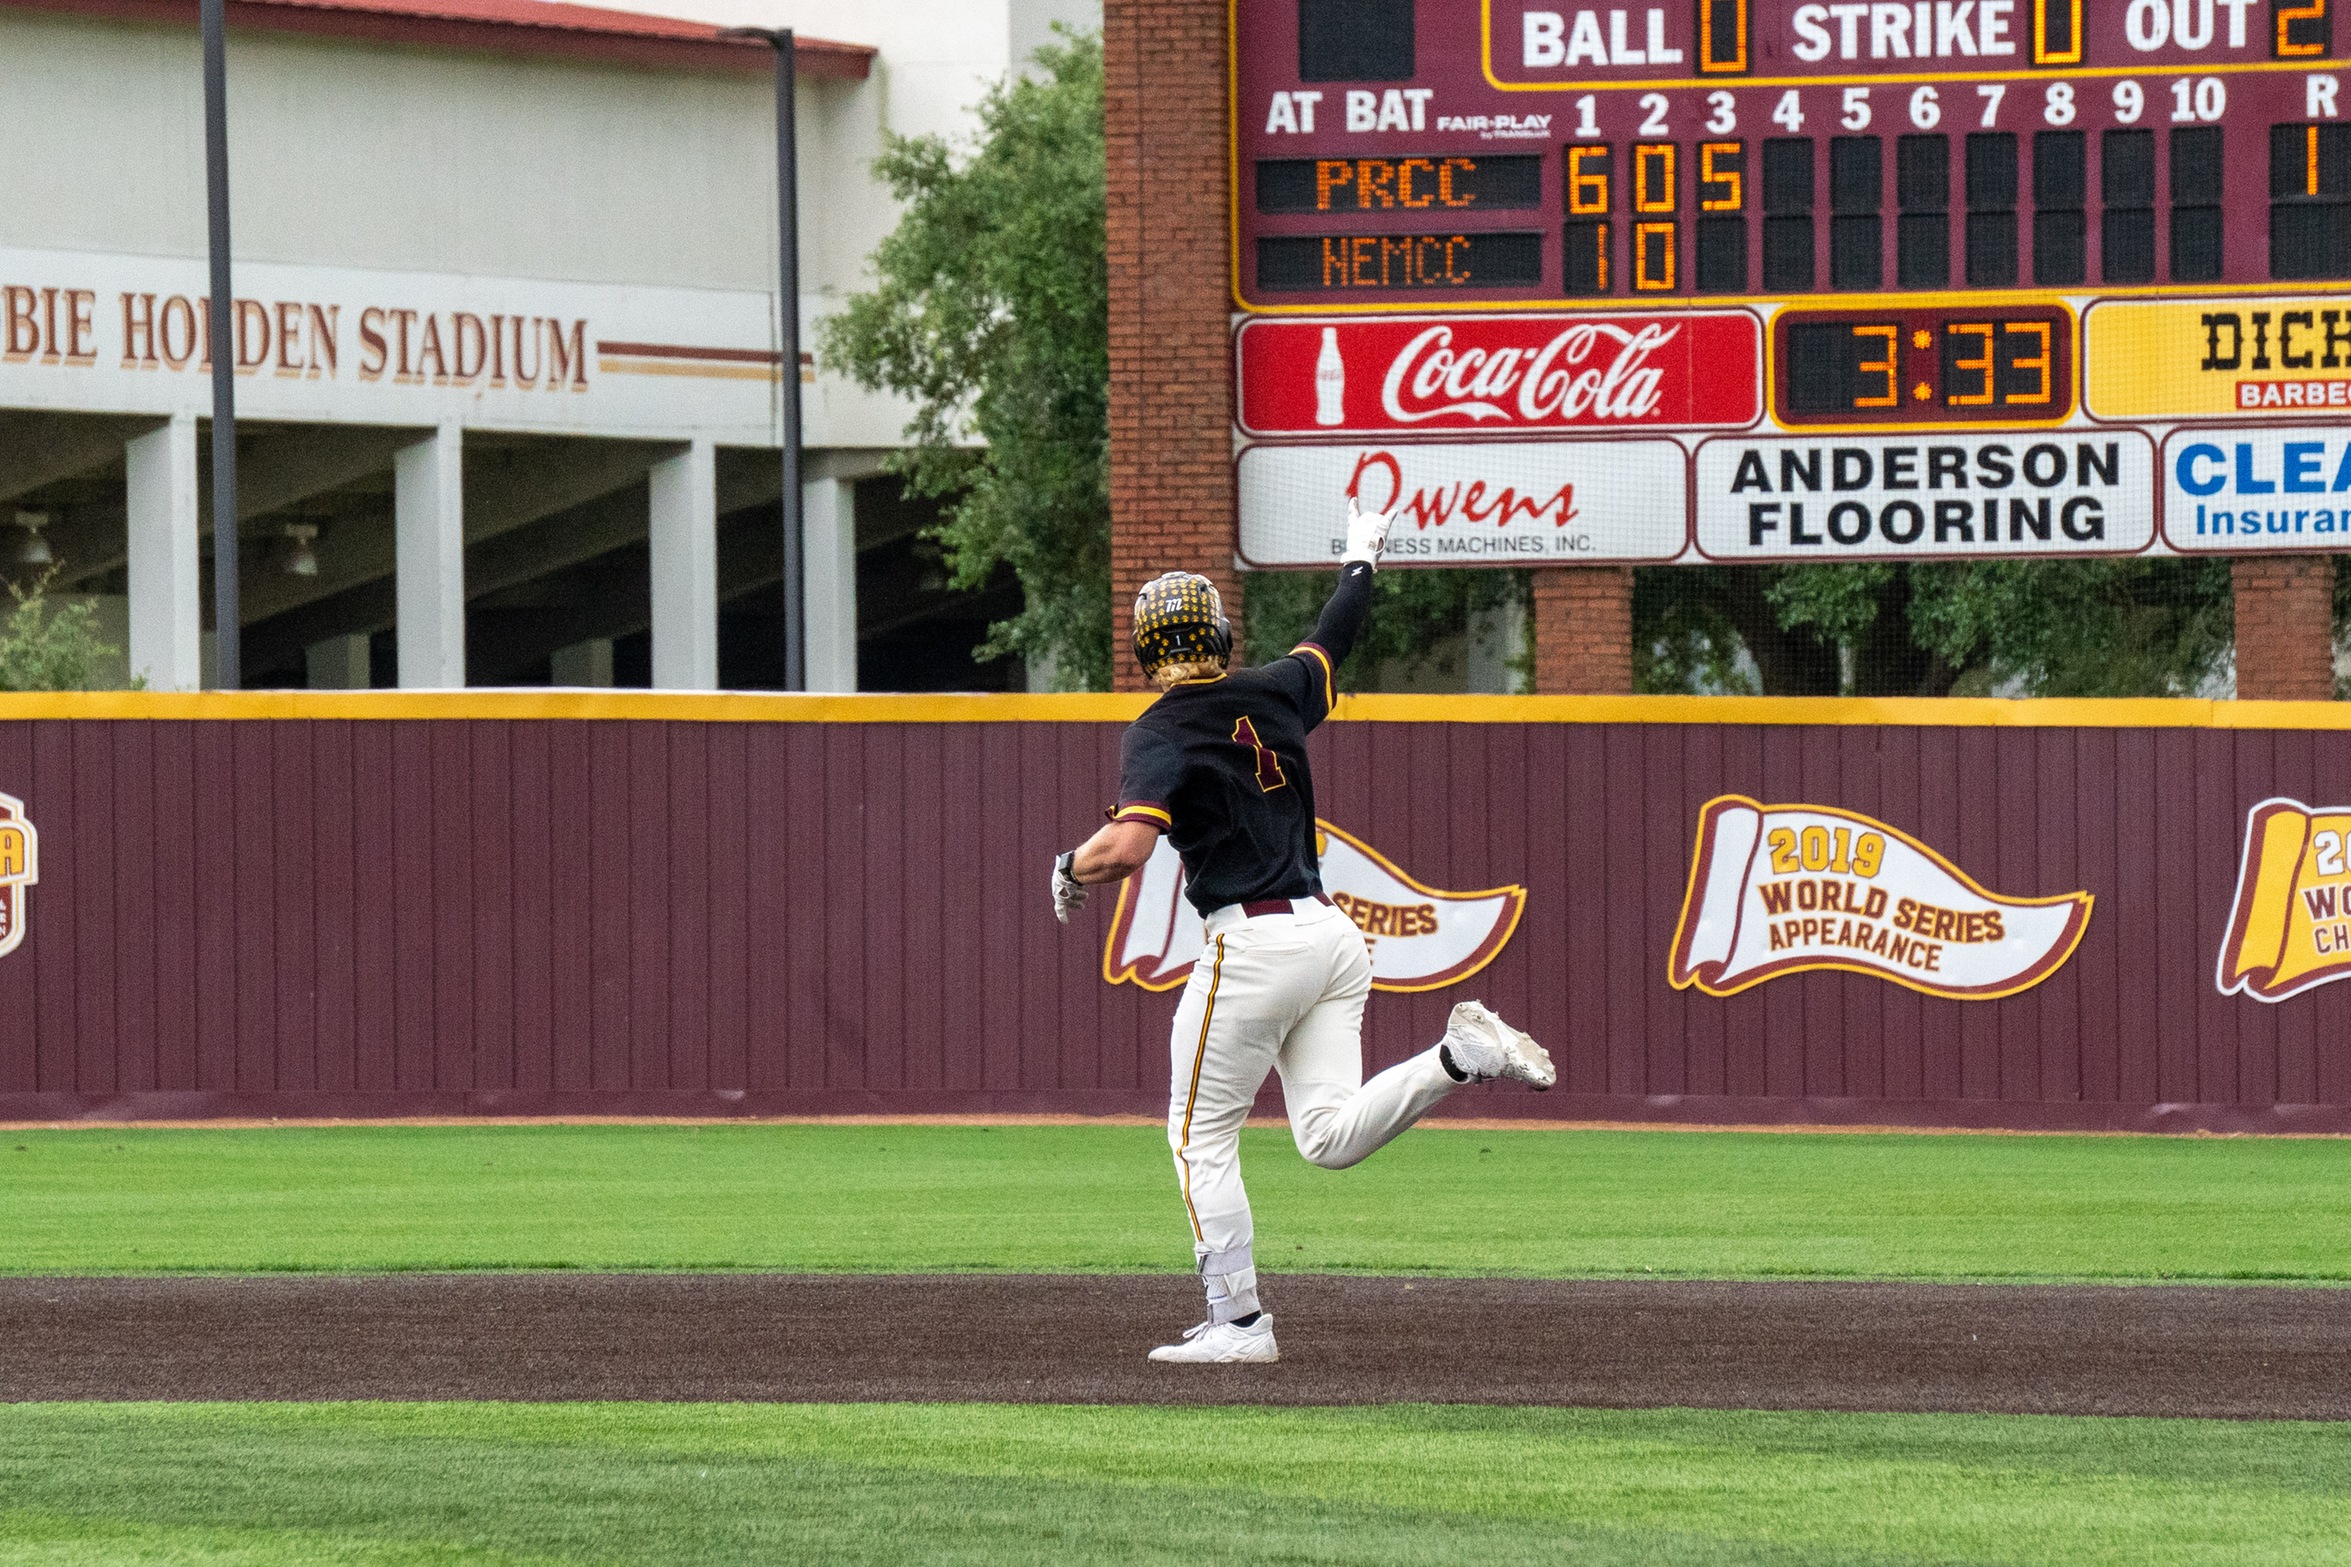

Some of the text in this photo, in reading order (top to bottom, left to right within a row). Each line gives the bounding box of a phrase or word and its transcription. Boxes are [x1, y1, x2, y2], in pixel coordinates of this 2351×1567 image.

[1522, 7, 1684, 67] BALL
[1792, 0, 2016, 62] STRIKE
[2125, 0, 2259, 52] OUT
[1265, 89, 1433, 134] AT BAT
[1574, 73, 2339, 138] 1 2 3 4 5 6 7 8 9 10 R
[1316, 157, 1477, 210] PRCC
[1568, 146, 1609, 214] 6
[1636, 143, 1675, 213] 0
[1702, 142, 1741, 211] 5
[1322, 222, 1676, 291] NEMCC 1 0
[1, 284, 589, 394] BIE HODEN STADIUM
[1852, 320, 2052, 408] 3:33
[1382, 323, 1682, 423] Coca-Cola
[2241, 381, 2351, 407] BARBE
[1345, 451, 1579, 530] Owens
[1730, 441, 2120, 494] ANDERSON
[1555, 534, 1597, 552] INC.
[1748, 495, 2106, 546] FLOORING
[1231, 715, 1287, 792] 1
[1767, 825, 1887, 879] 2019
[2313, 829, 2351, 877] 2
[1758, 879, 2006, 944] WORLD SERIES
[1767, 918, 1944, 973] APPEARANCE
